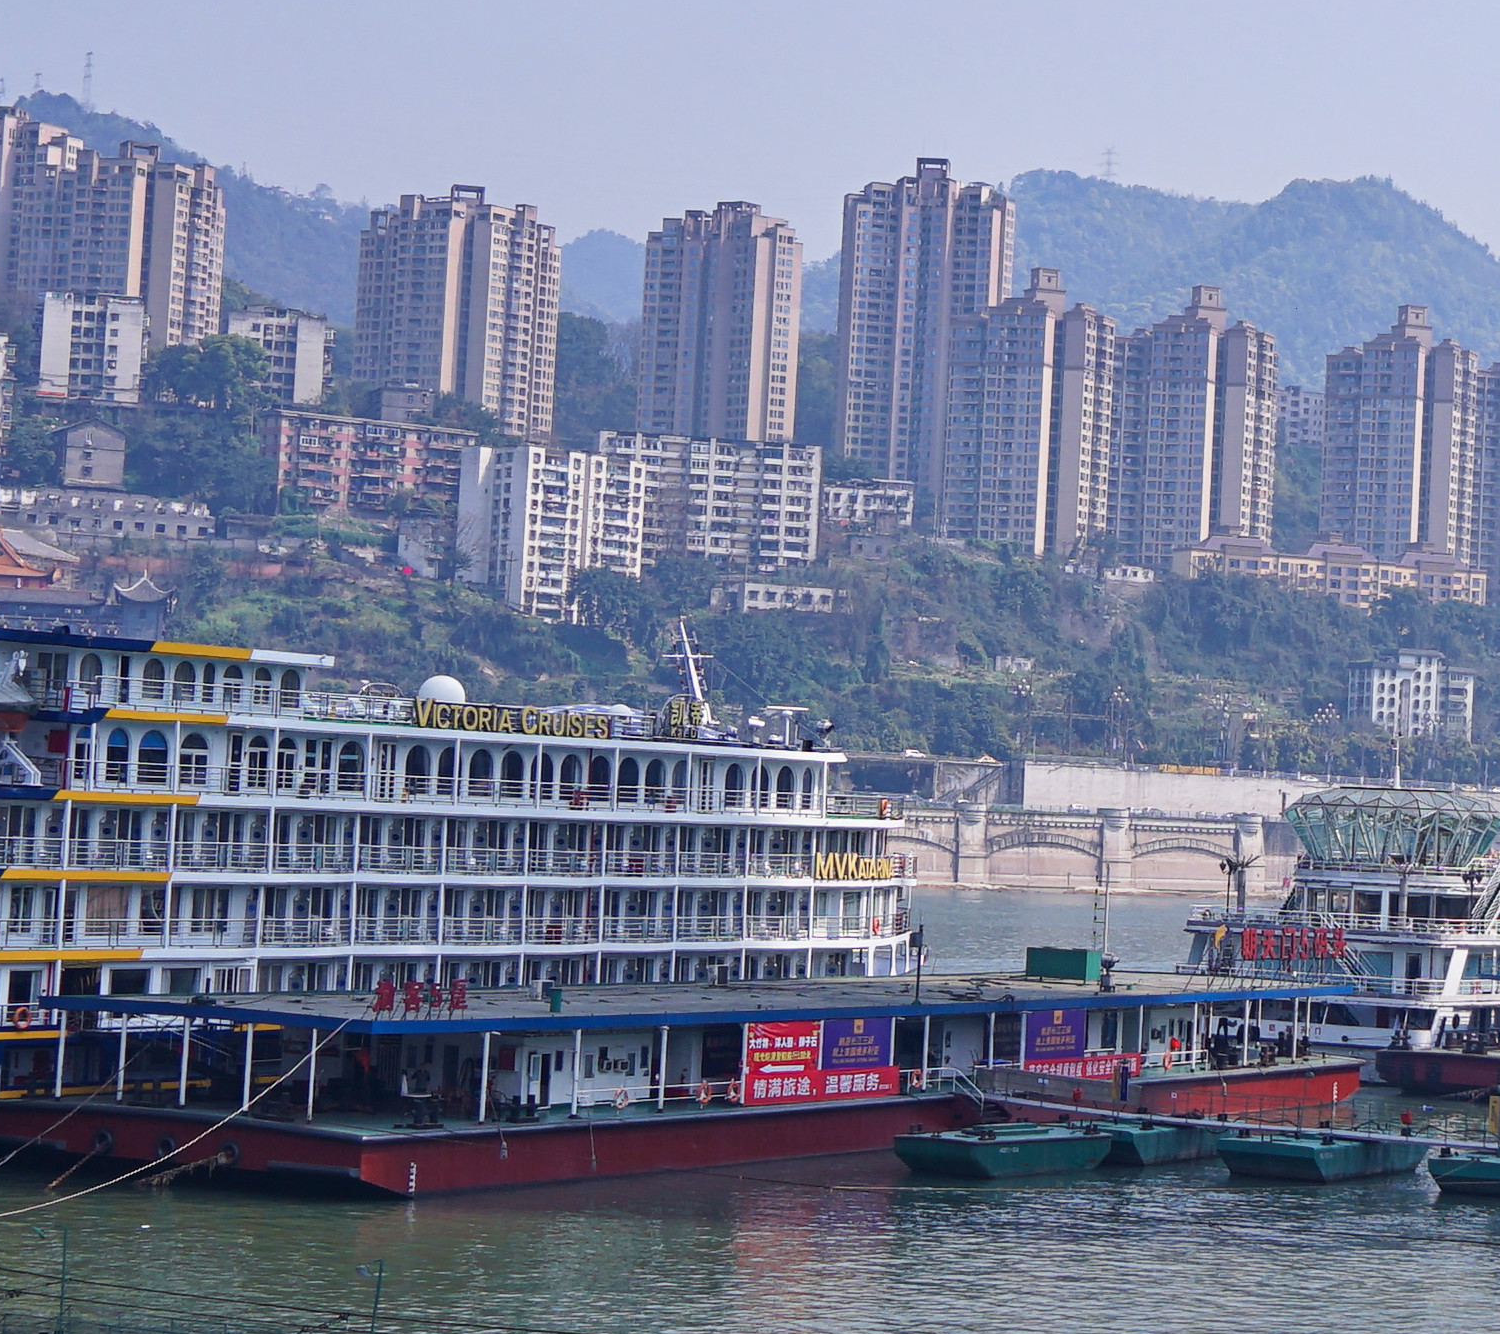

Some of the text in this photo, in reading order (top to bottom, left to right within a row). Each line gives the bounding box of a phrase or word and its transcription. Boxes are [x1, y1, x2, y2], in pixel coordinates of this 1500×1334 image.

[415, 696, 610, 739] VICTORIA CRUISES
[1241, 927, 1347, 960] 朝天门5码头
